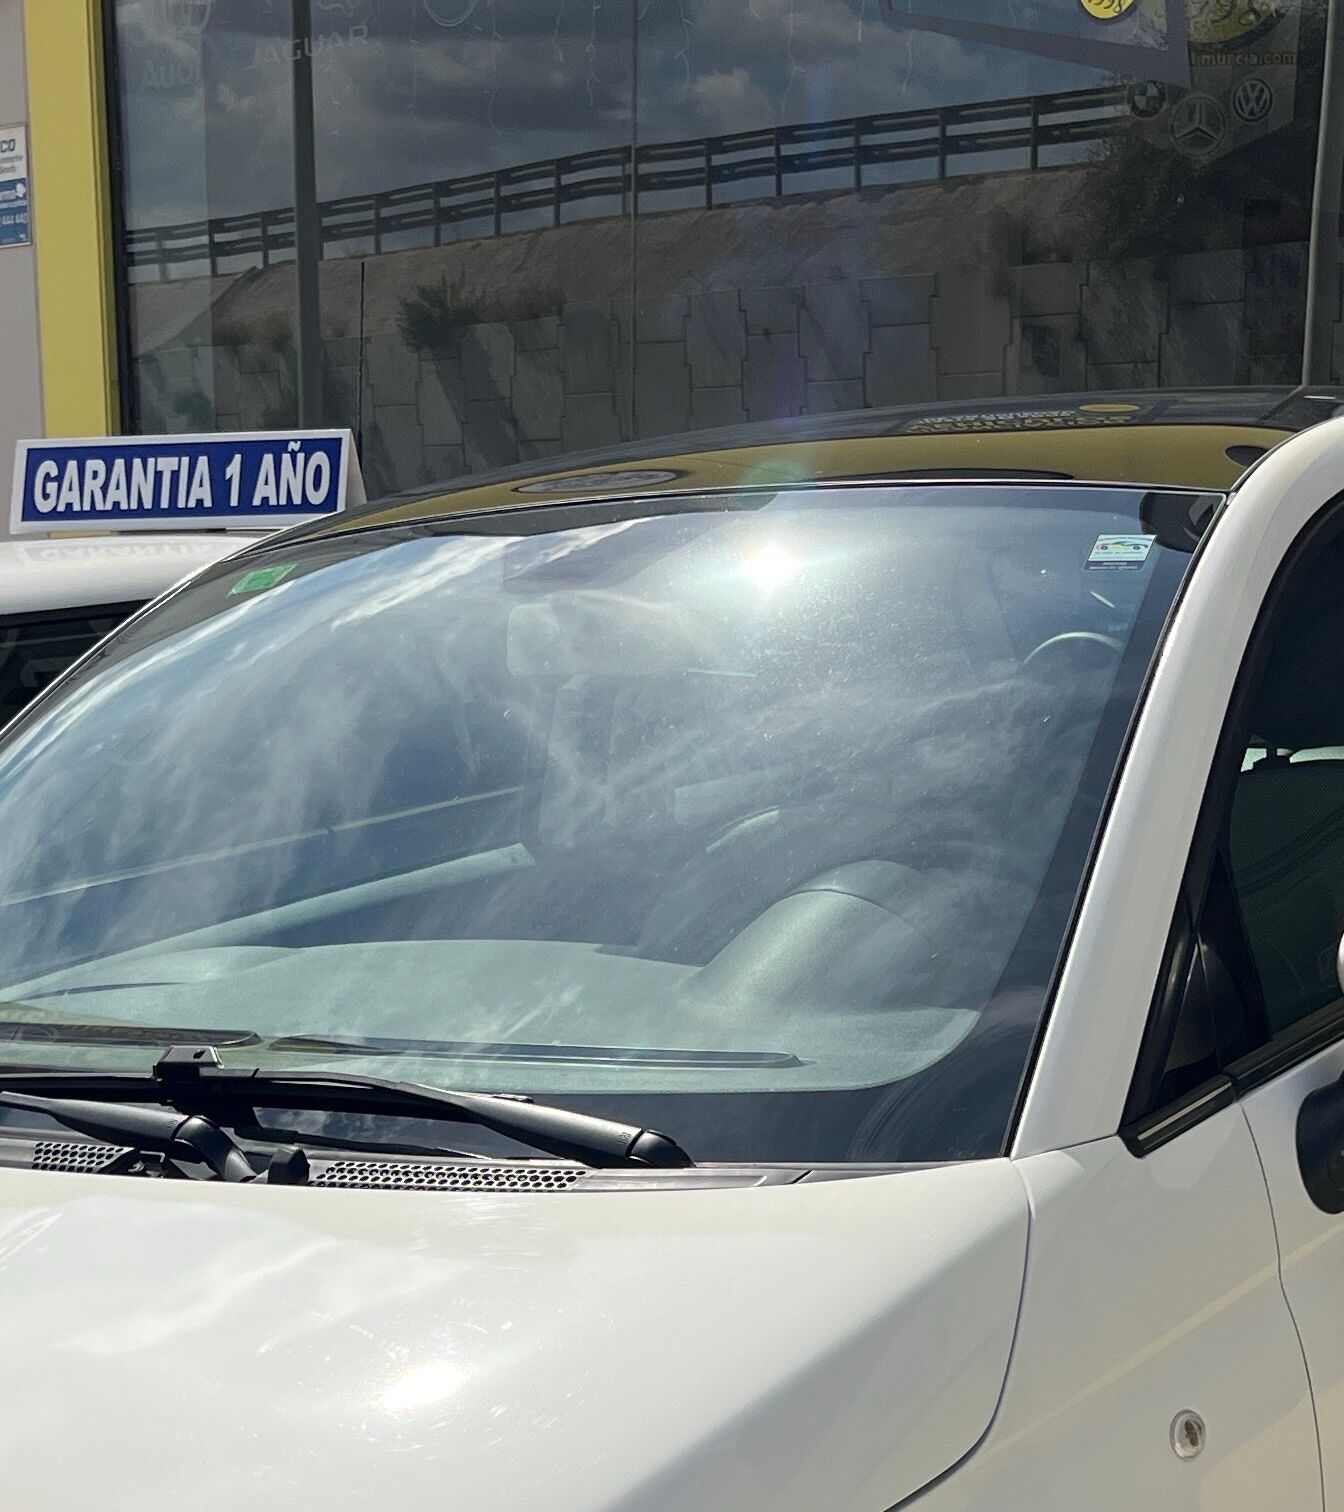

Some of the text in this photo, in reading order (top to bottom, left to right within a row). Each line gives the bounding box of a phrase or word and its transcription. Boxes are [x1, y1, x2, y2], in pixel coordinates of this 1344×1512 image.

[245, 24, 369, 71] JAGUAR
[33, 440, 332, 513] GARANTIA 1 AÑO
